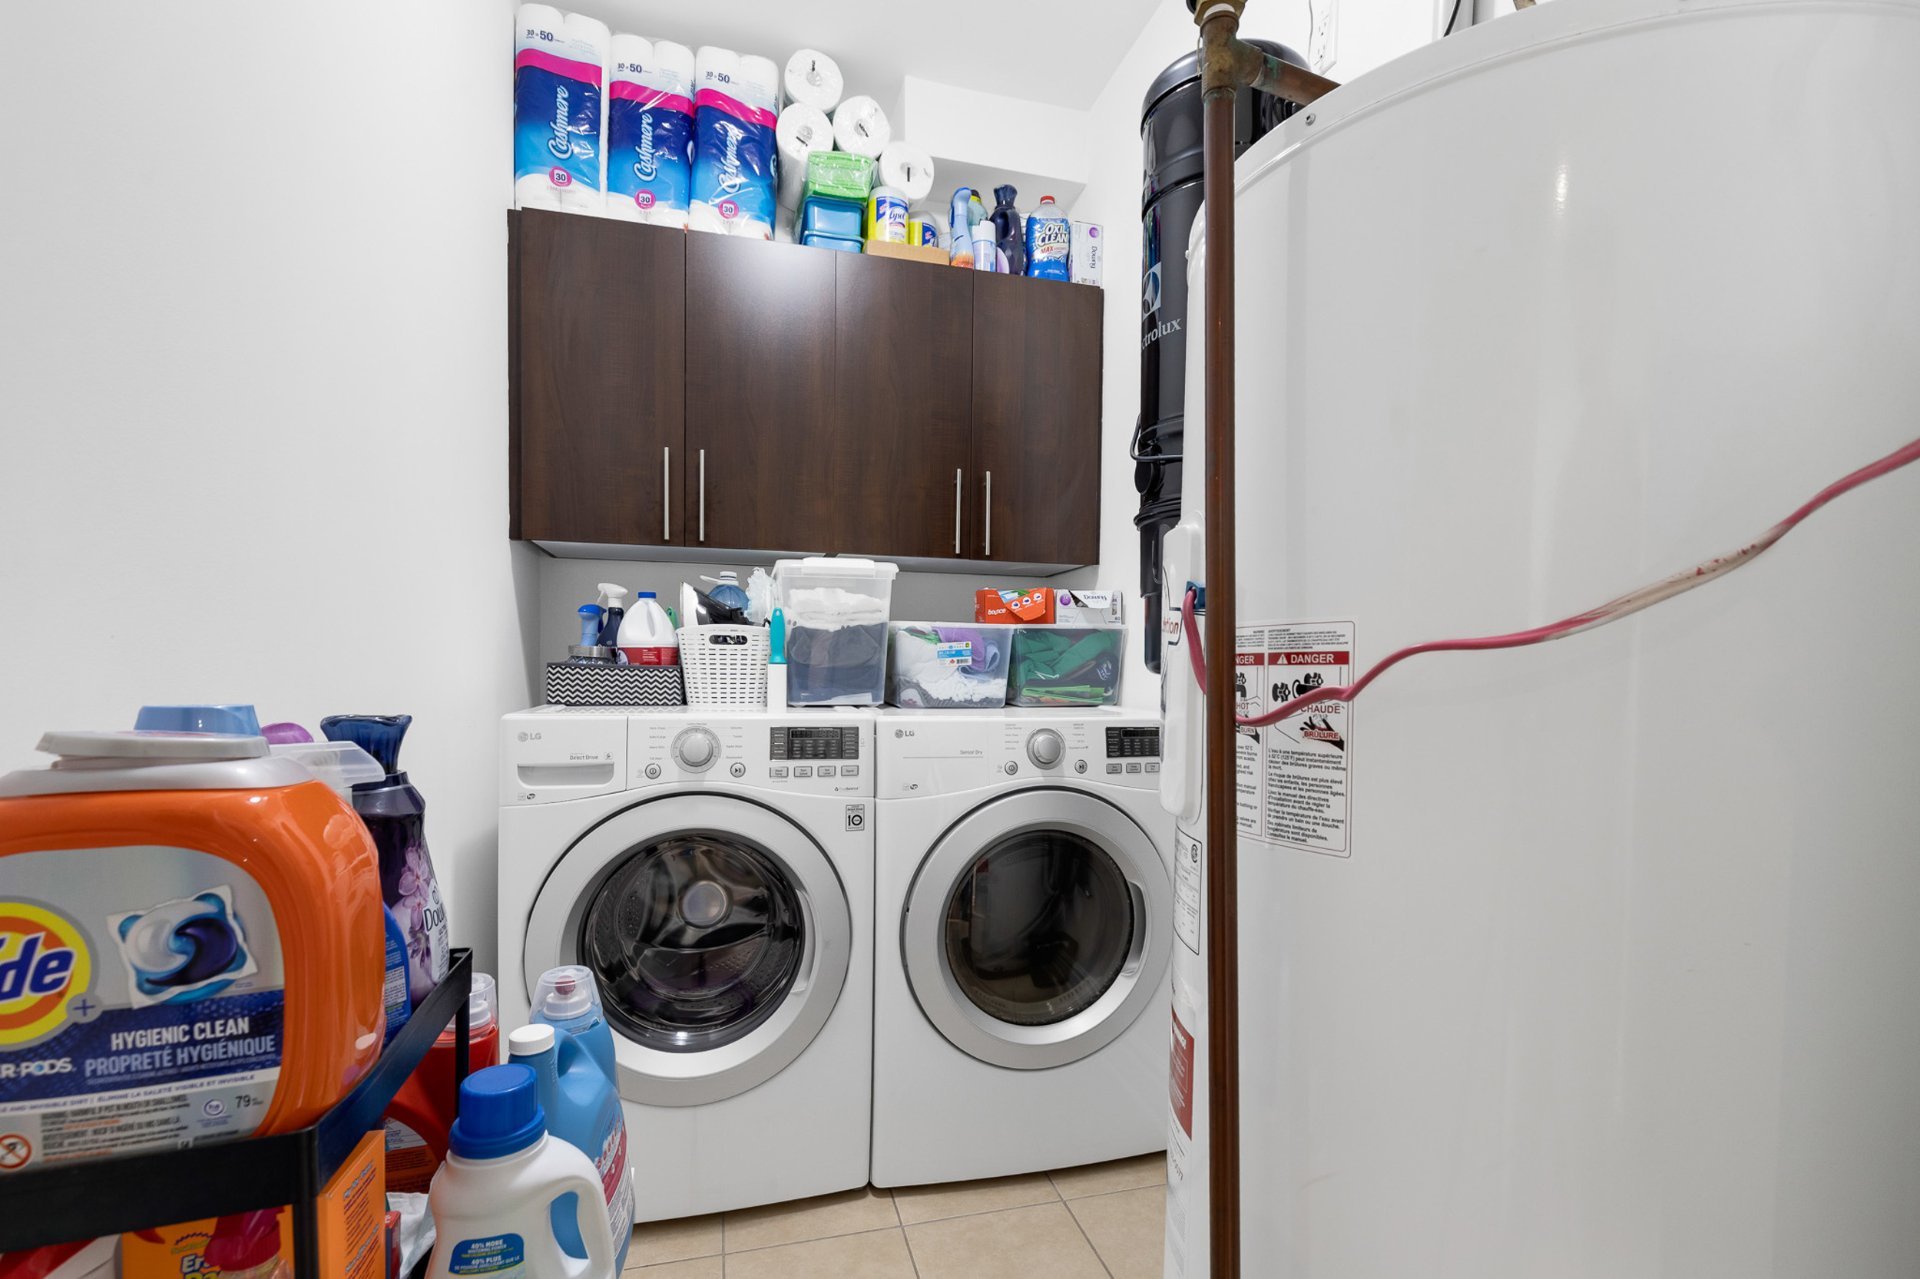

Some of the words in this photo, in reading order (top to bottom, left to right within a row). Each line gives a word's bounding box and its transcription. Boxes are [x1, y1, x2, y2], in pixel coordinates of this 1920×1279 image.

[540, 30, 554, 42] 50
[629, 63, 642, 73] 50
[718, 72, 730, 84] 50
[547, 85, 573, 160] Cashmere
[633, 112, 658, 182] Cashmere
[555, 172, 567, 182] 30
[640, 195, 651, 204] 30
[723, 206, 734, 214] 30
[1045, 223, 1064, 234] OXI
[1037, 233, 1068, 246] CLEAN
[1236, 656, 1254, 664] NGER
[1290, 654, 1334, 664] DANGER
[1301, 706, 1340, 714] CHAUDE
[1304, 730, 1339, 738] BRÛLURE
[0, 934, 75, 1000] de
[111, 1024, 190, 1052] HYGIENIC
[194, 1016, 250, 1040] CLEAN
[84, 1045, 174, 1078] PROPRETÉ
[176, 1034, 276, 1066] HYGIÉNIQUE
[235, 1094, 251, 1108] 79
[486, 1239, 503, 1247] MORE
